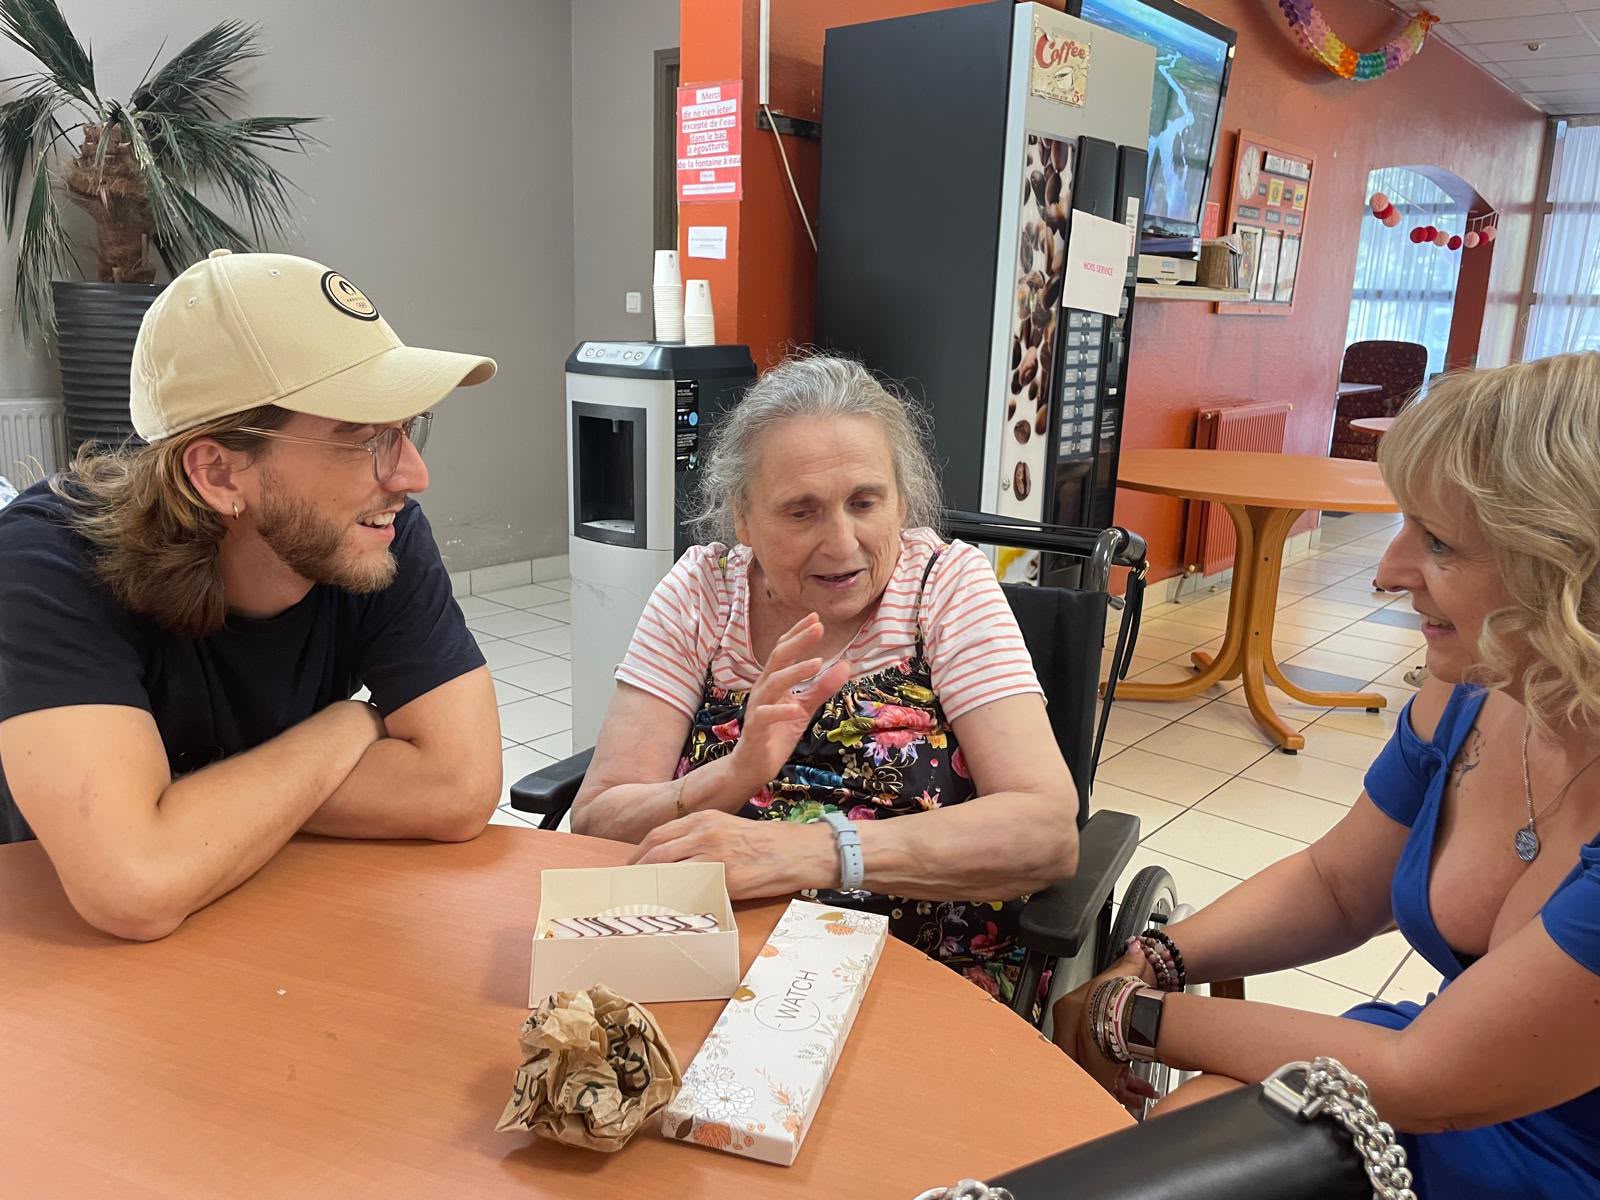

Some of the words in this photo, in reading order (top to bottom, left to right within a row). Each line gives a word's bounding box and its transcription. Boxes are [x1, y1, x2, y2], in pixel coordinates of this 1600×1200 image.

[1036, 33, 1086, 69] Coffee
[701, 91, 720, 101] Merci
[683, 109, 692, 119] de
[702, 107, 716, 116] rien
[716, 105, 732, 116] jeter
[709, 120, 718, 128] de
[718, 118, 736, 128] l'eau
[690, 134, 705, 143] dans
[707, 132, 713, 140] le
[714, 131, 726, 139] bac
[677, 160, 686, 169] de
[687, 159, 694, 168] la
[695, 157, 722, 168] fontaine
[723, 155, 728, 165] à
[774, 969, 819, 1019] WATCH
